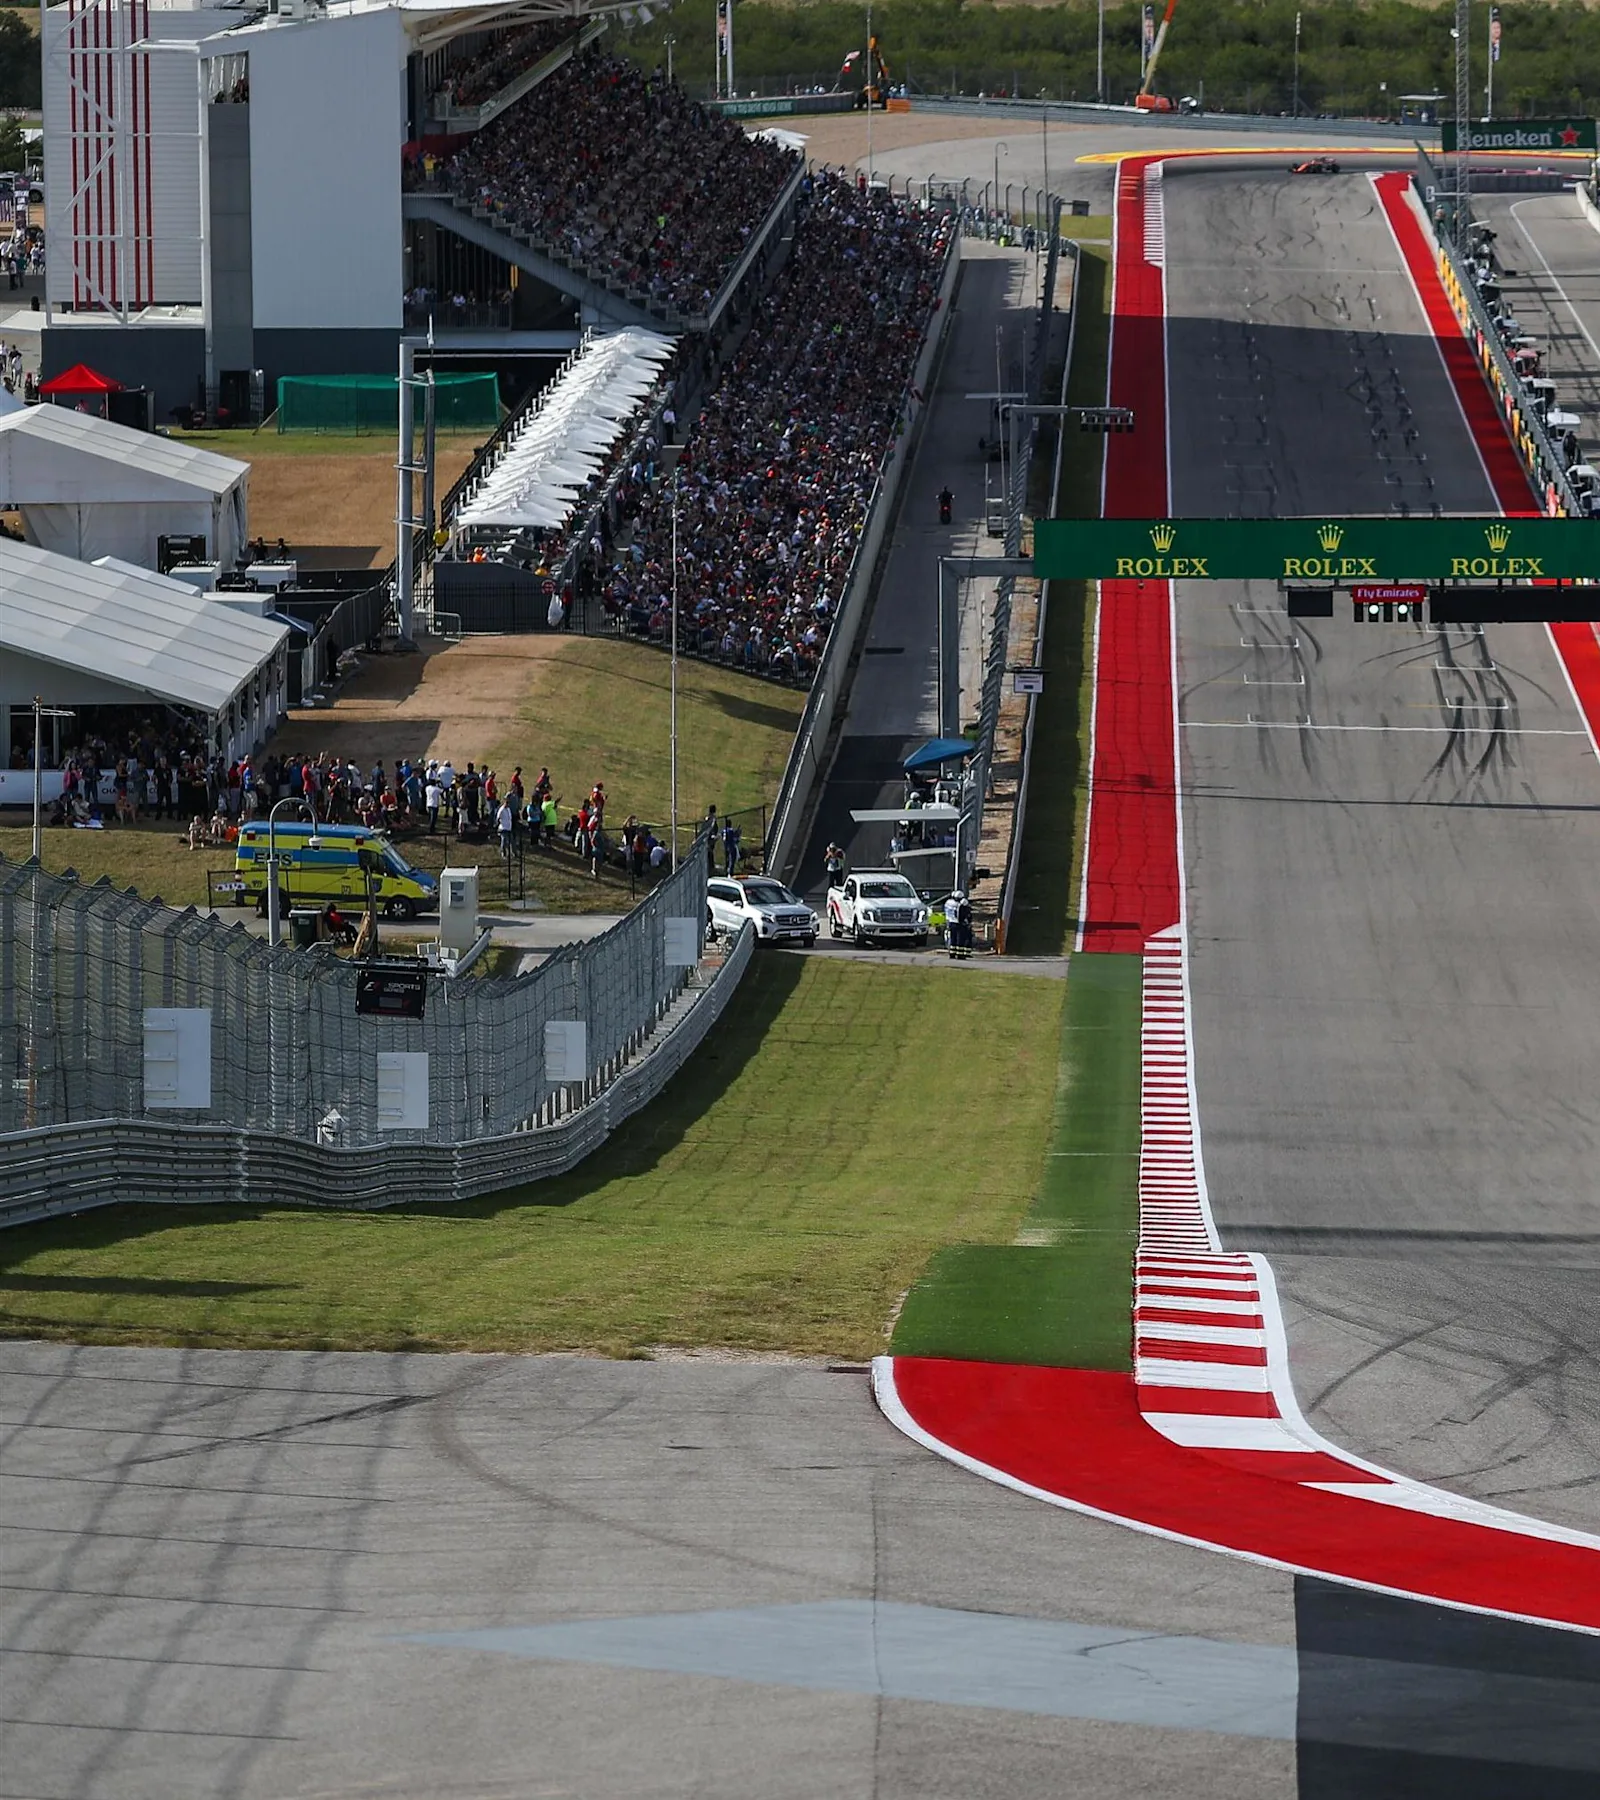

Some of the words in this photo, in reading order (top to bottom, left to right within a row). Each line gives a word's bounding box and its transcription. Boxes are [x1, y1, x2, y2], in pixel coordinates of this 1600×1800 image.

[1116, 557, 1210, 576] ROLEX
[1283, 557, 1377, 576] ROLEX
[1450, 557, 1544, 576] ROLEX
[1357, 588, 1375, 599] Fly
[1376, 588, 1420, 598] Emirates
